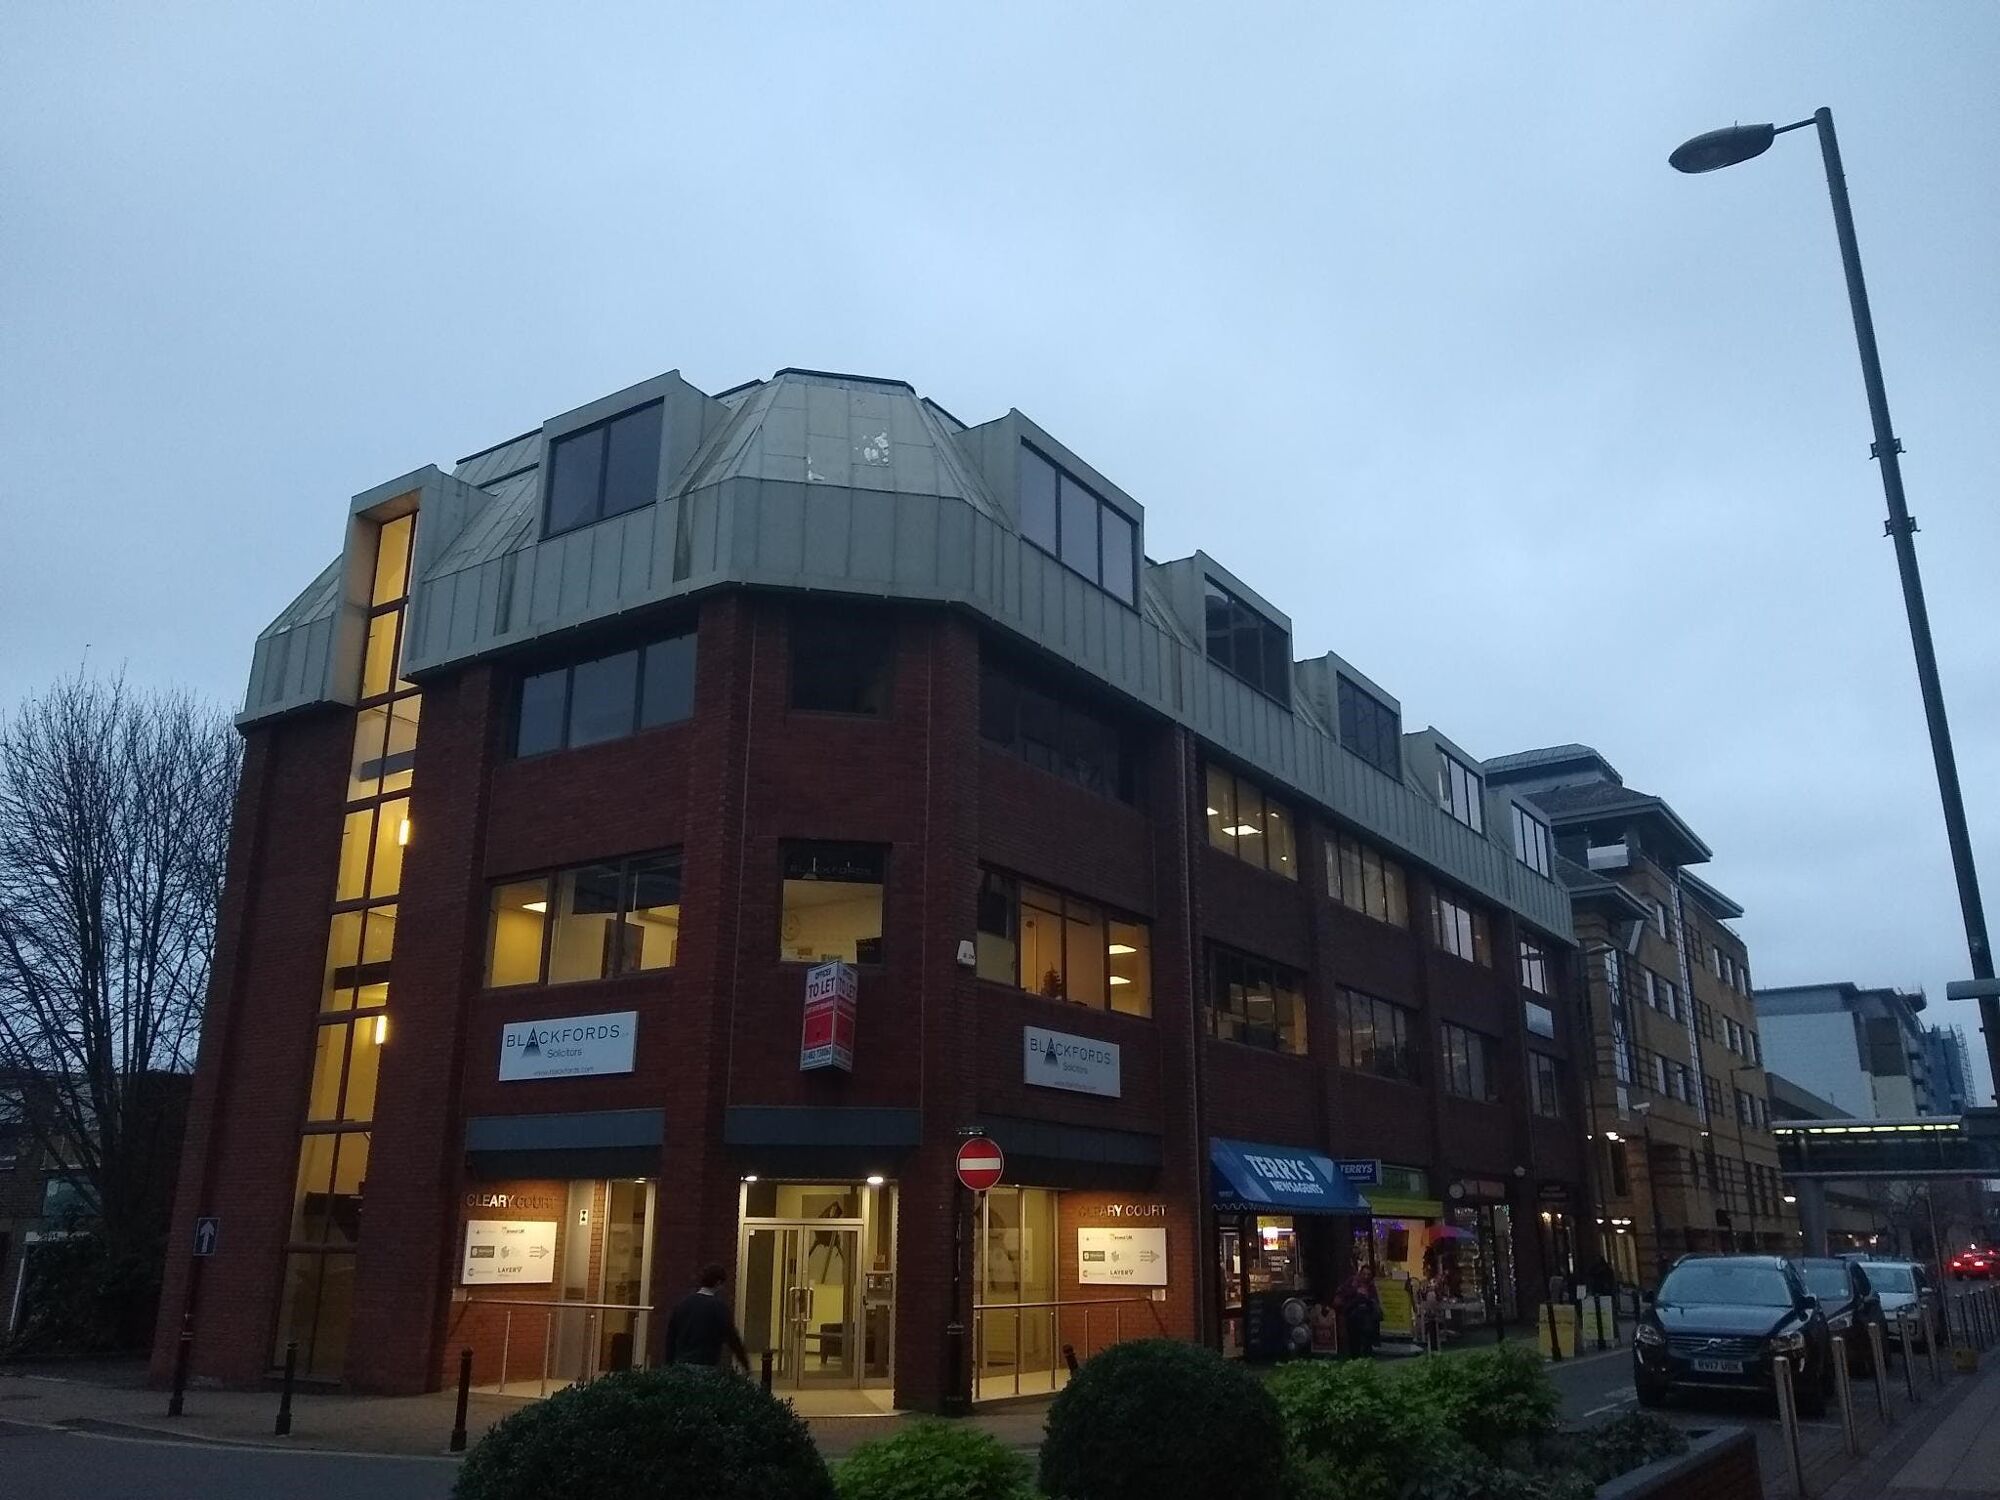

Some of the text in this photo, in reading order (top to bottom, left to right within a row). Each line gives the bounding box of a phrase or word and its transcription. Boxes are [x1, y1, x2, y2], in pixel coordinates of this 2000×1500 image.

[808, 977, 836, 999] TO LET
[506, 1024, 620, 1048] BLACKFORDS
[546, 1047, 583, 1060] Solicitors
[1029, 1037, 1112, 1065] BLACKFORDS
[1243, 1154, 1316, 1183] TERRYS
[1339, 1163, 1374, 1175] TERRYS
[1269, 1180, 1325, 1196] NEWSAGENTS
[466, 1194, 556, 1209] CLEARY COURT
[1078, 1203, 1168, 1217] CLEARY COURT
